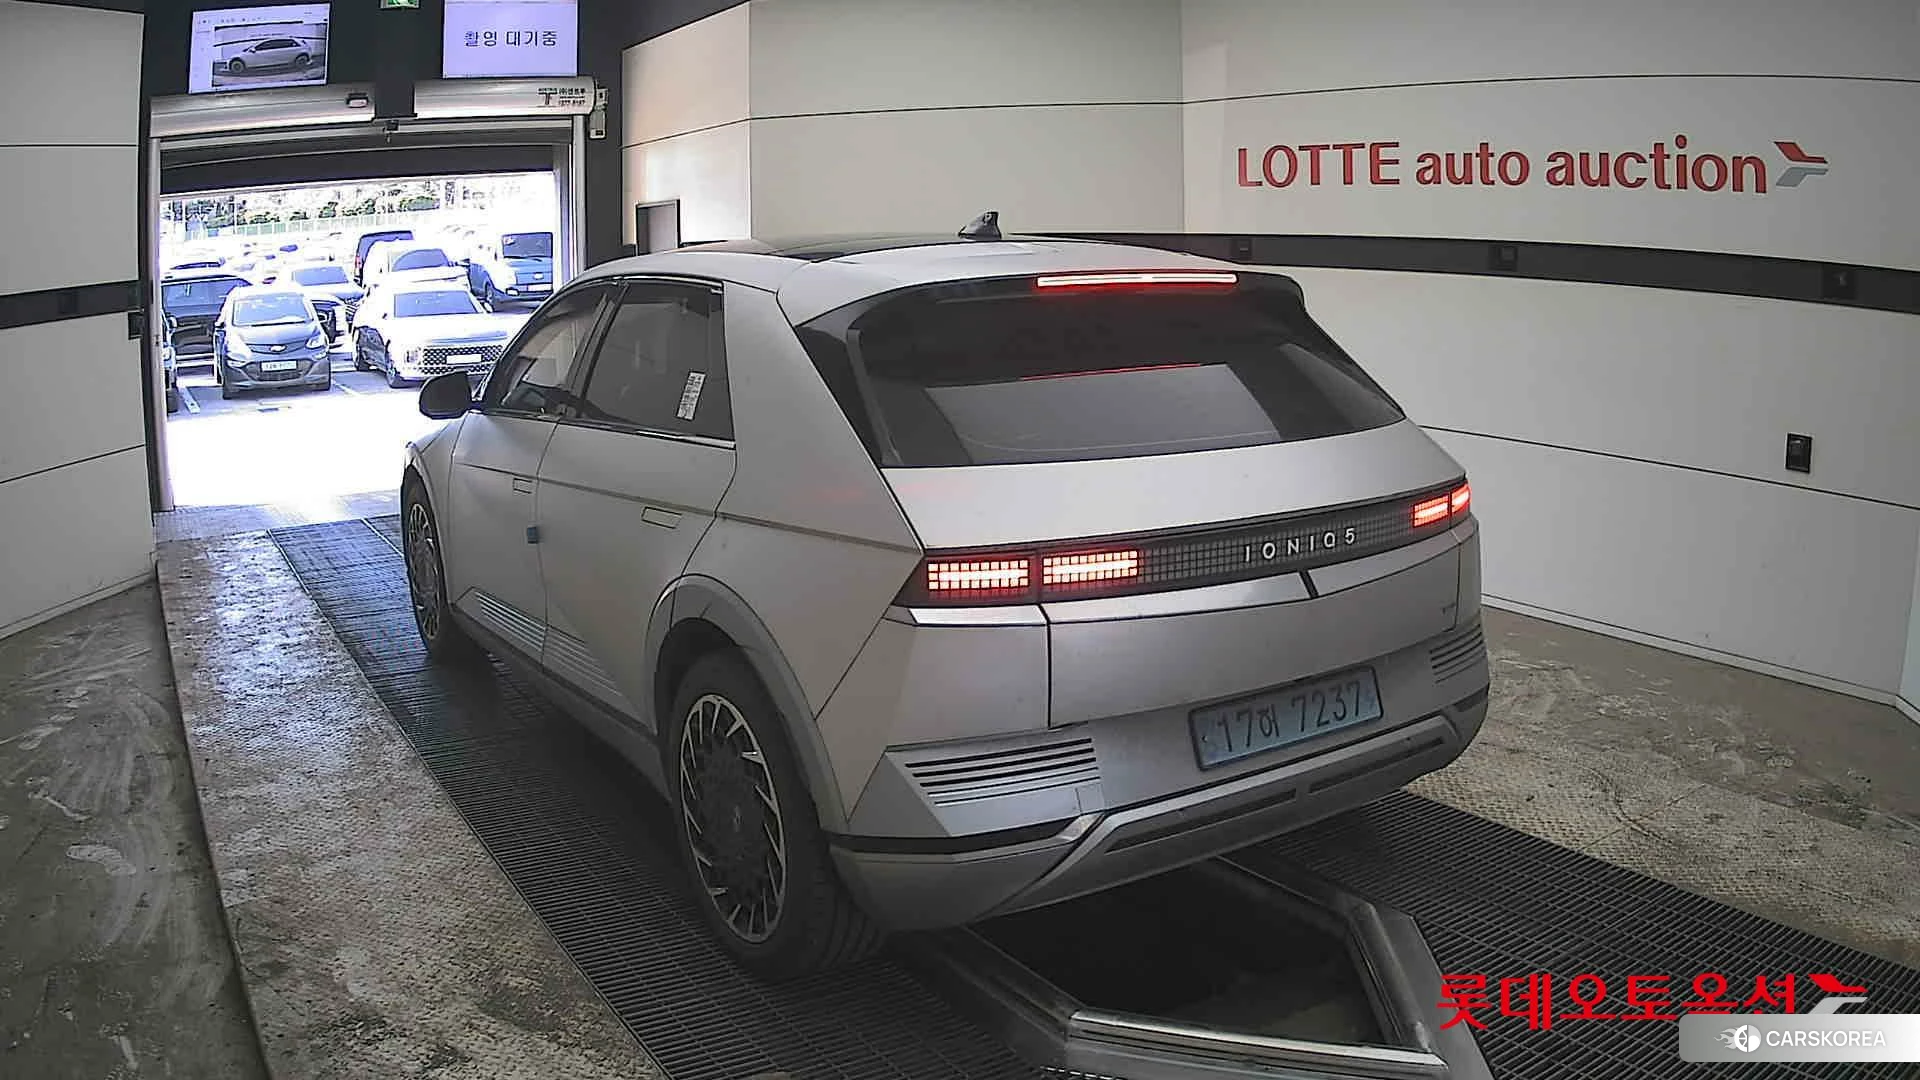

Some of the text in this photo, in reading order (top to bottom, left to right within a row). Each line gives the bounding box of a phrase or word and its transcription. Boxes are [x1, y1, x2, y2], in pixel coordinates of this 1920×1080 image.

[505, 31, 557, 47] 대기중
[1237, 134, 1767, 194] LOTTE auto auction
[1290, 680, 1361, 732] 7237
